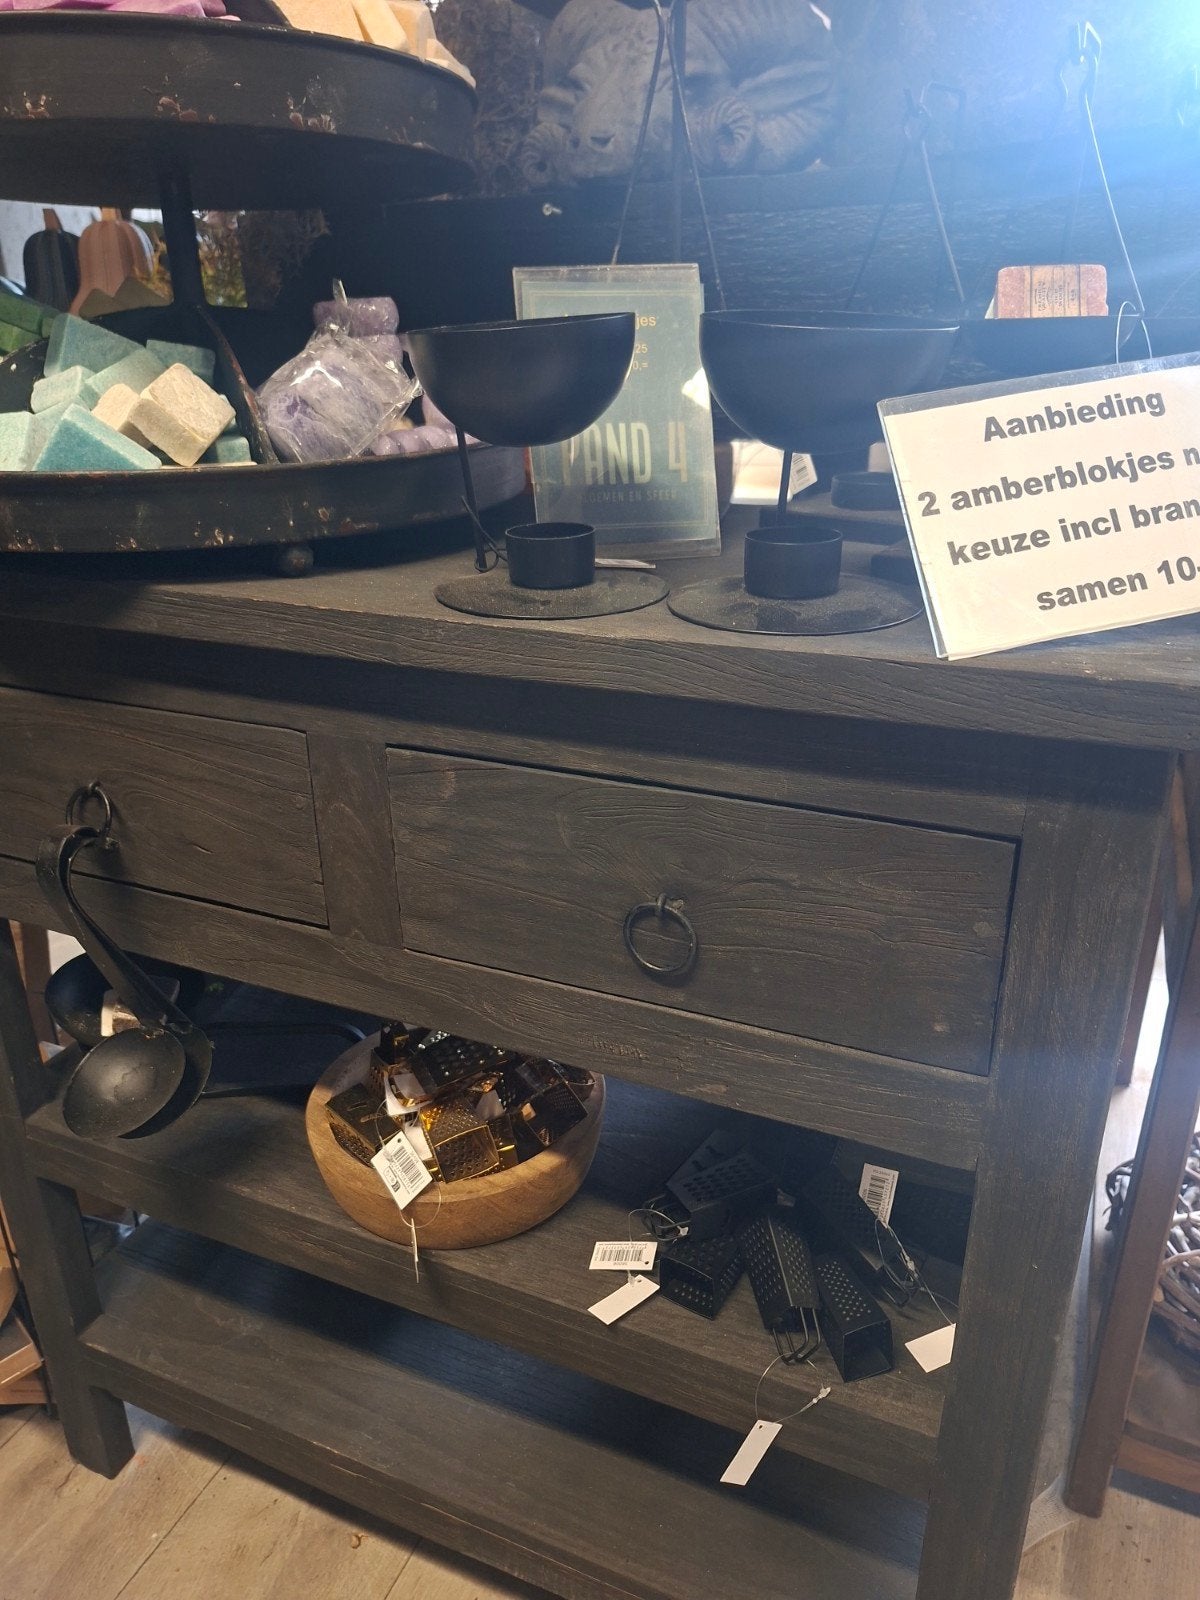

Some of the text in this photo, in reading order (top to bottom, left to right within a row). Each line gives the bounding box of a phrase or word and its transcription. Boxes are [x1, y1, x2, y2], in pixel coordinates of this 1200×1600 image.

[635, 312, 657, 330] jes
[635, 343, 648, 354] 25
[984, 391, 1166, 442] Aanbieding
[561, 421, 688, 486] PAND 4
[917, 491, 940, 517] 2
[950, 450, 1175, 511] amberblokjes
[947, 498, 1200, 566] keuze incl bran
[1036, 572, 1148, 611] samen
